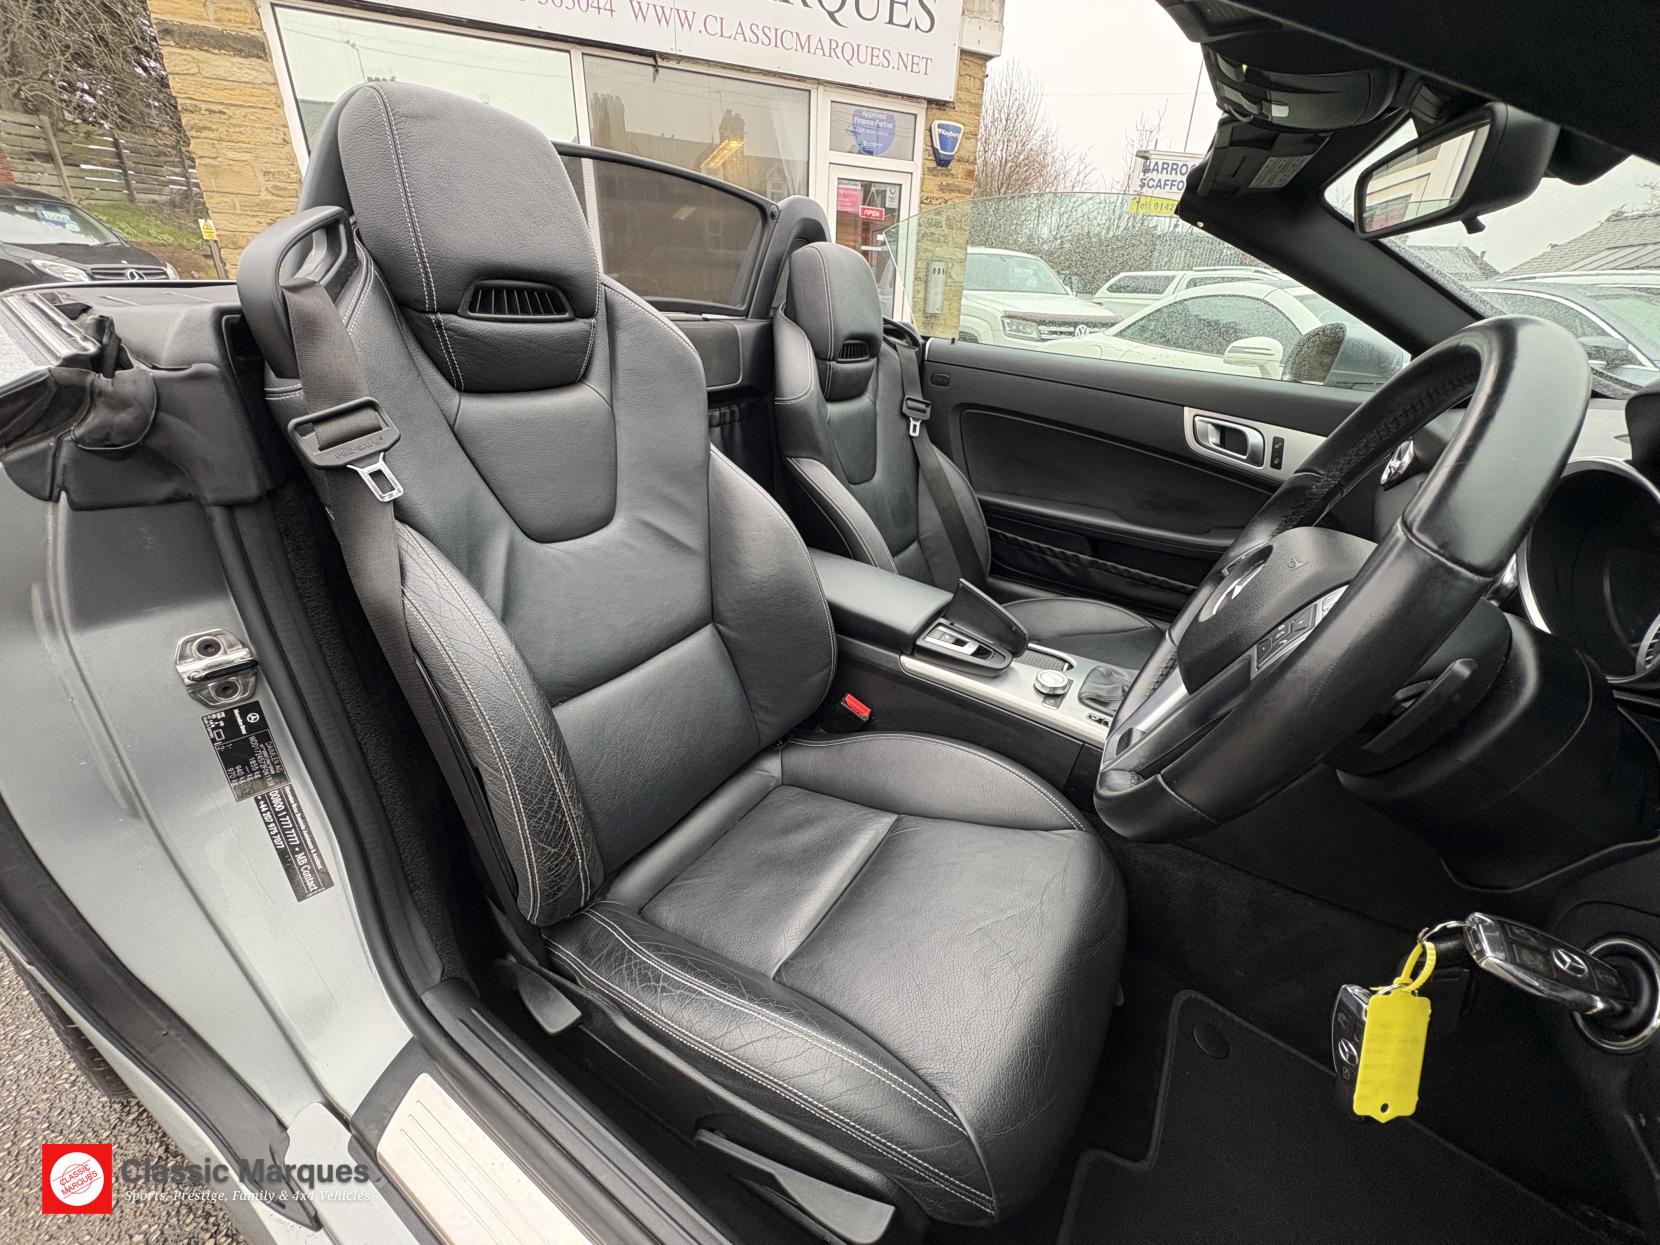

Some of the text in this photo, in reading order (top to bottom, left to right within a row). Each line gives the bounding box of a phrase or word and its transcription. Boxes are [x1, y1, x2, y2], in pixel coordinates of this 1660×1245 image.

[863, 209, 880, 217] OPEN
[265, 741, 283, 774] DAIMLER AG
[259, 800, 269, 812] +44
[269, 790, 284, 811] 00800
[263, 812, 273, 823] 207
[280, 816, 292, 829] 777
[272, 835, 284, 849] 7077
[285, 828, 299, 845] 7777
[294, 852, 308, 866] MB
[300, 865, 319, 892] Contact
